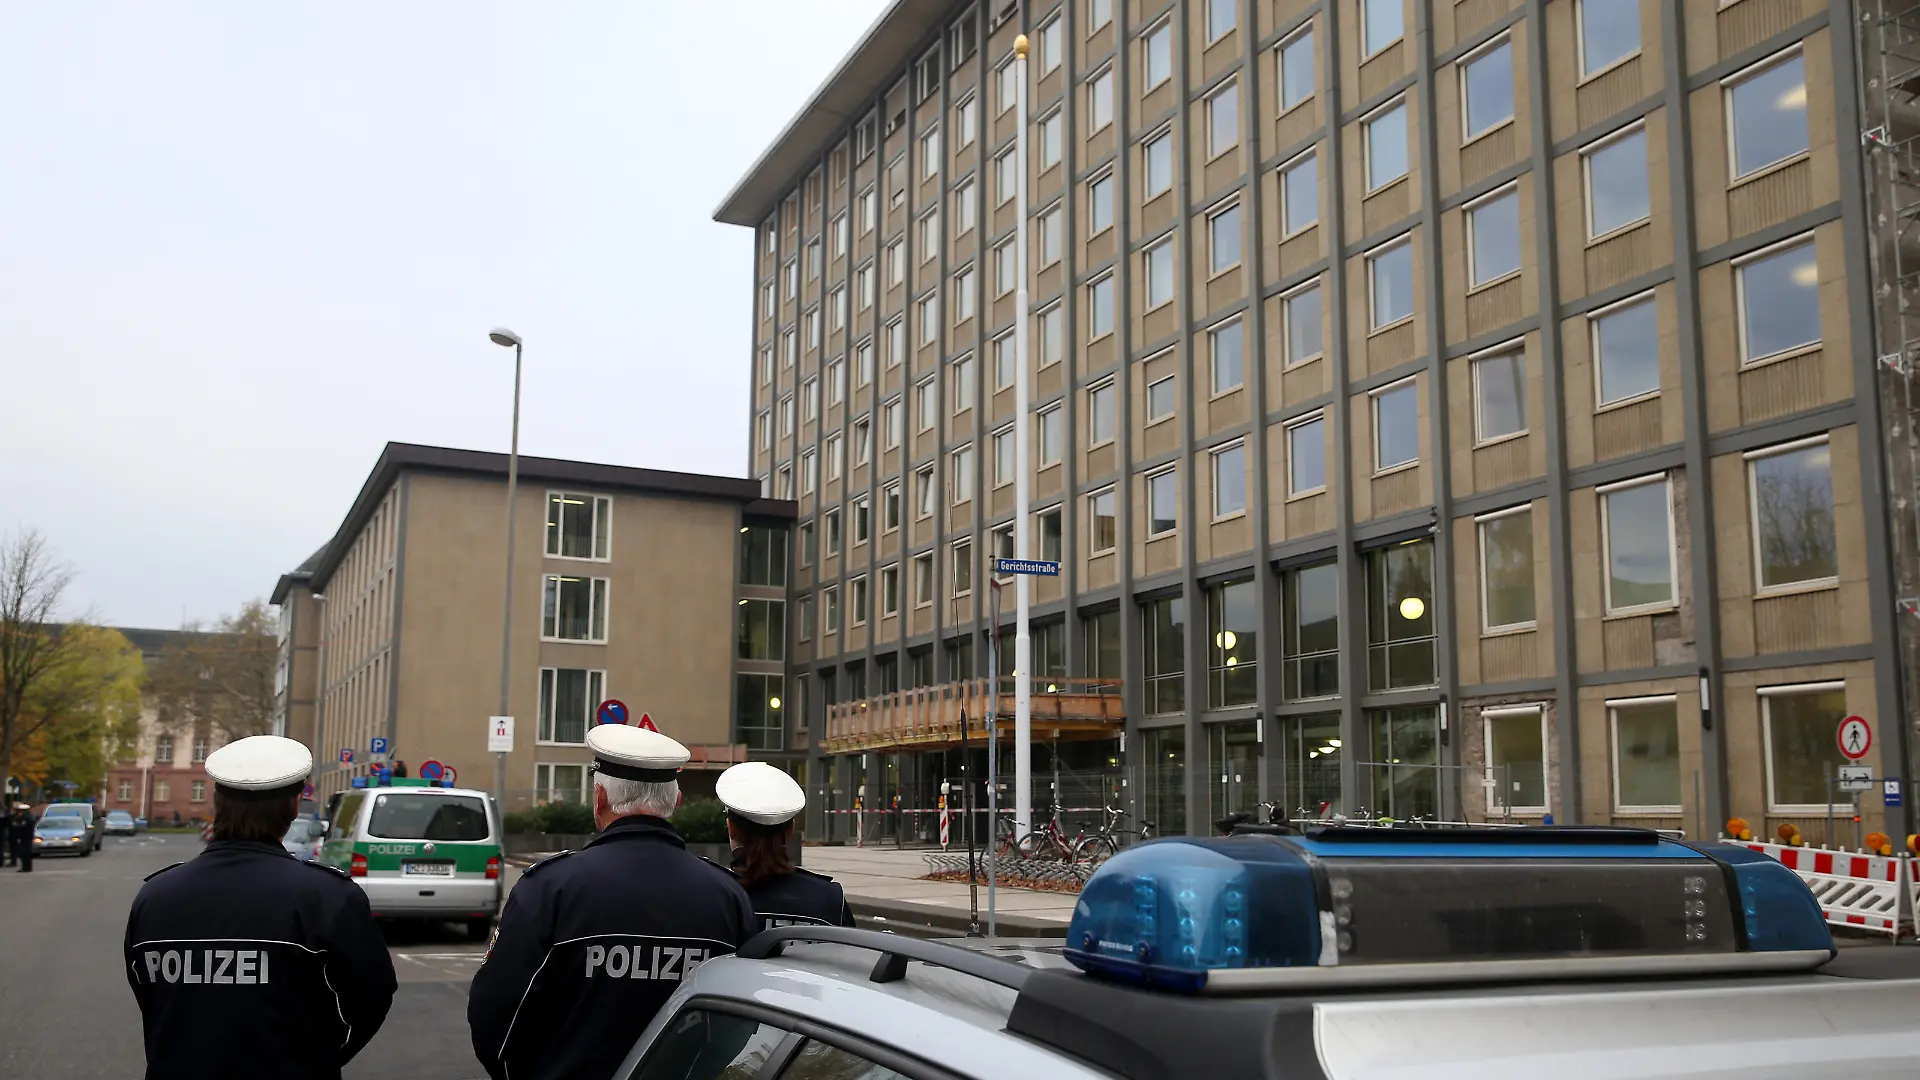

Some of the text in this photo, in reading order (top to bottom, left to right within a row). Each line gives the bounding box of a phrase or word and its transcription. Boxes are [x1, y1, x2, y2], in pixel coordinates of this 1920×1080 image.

[1000, 561, 1056, 573] Gerichtsstraße
[368, 843, 417, 855] POLIZEI
[144, 949, 269, 984] POLIZEI
[585, 945, 710, 981] POLIZE
